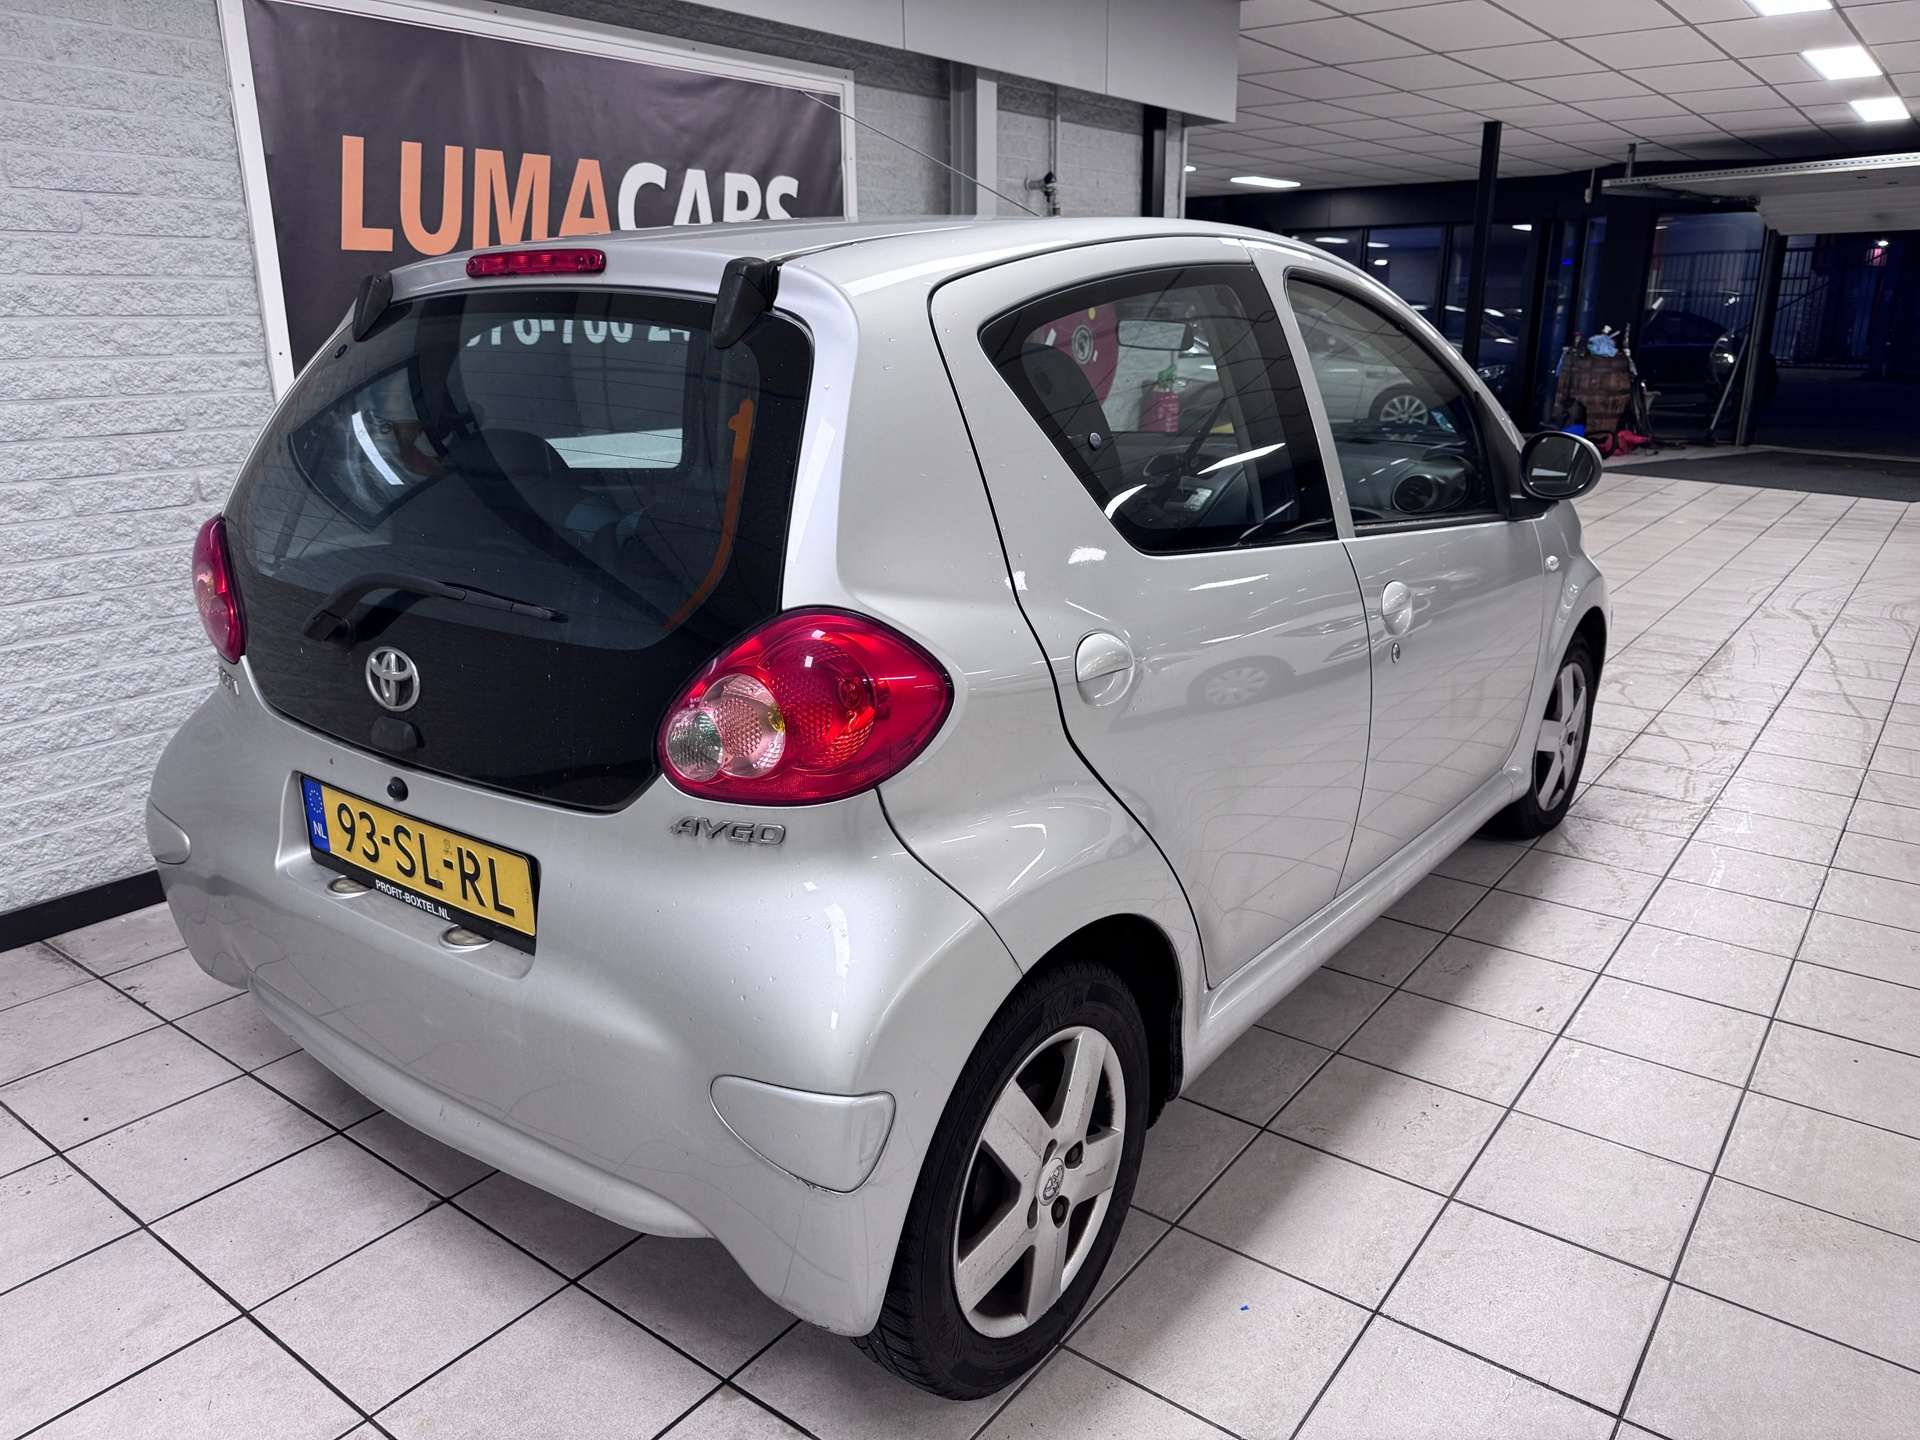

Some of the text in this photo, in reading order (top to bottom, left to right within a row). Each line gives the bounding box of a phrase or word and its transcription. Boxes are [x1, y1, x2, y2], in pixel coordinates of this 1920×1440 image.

[312, 820, 328, 840] NL
[669, 815, 787, 845] AYGO
[336, 801, 516, 918] 93-SL-RL
[375, 879, 452, 921] PROFIT-BOXTEL.NL
